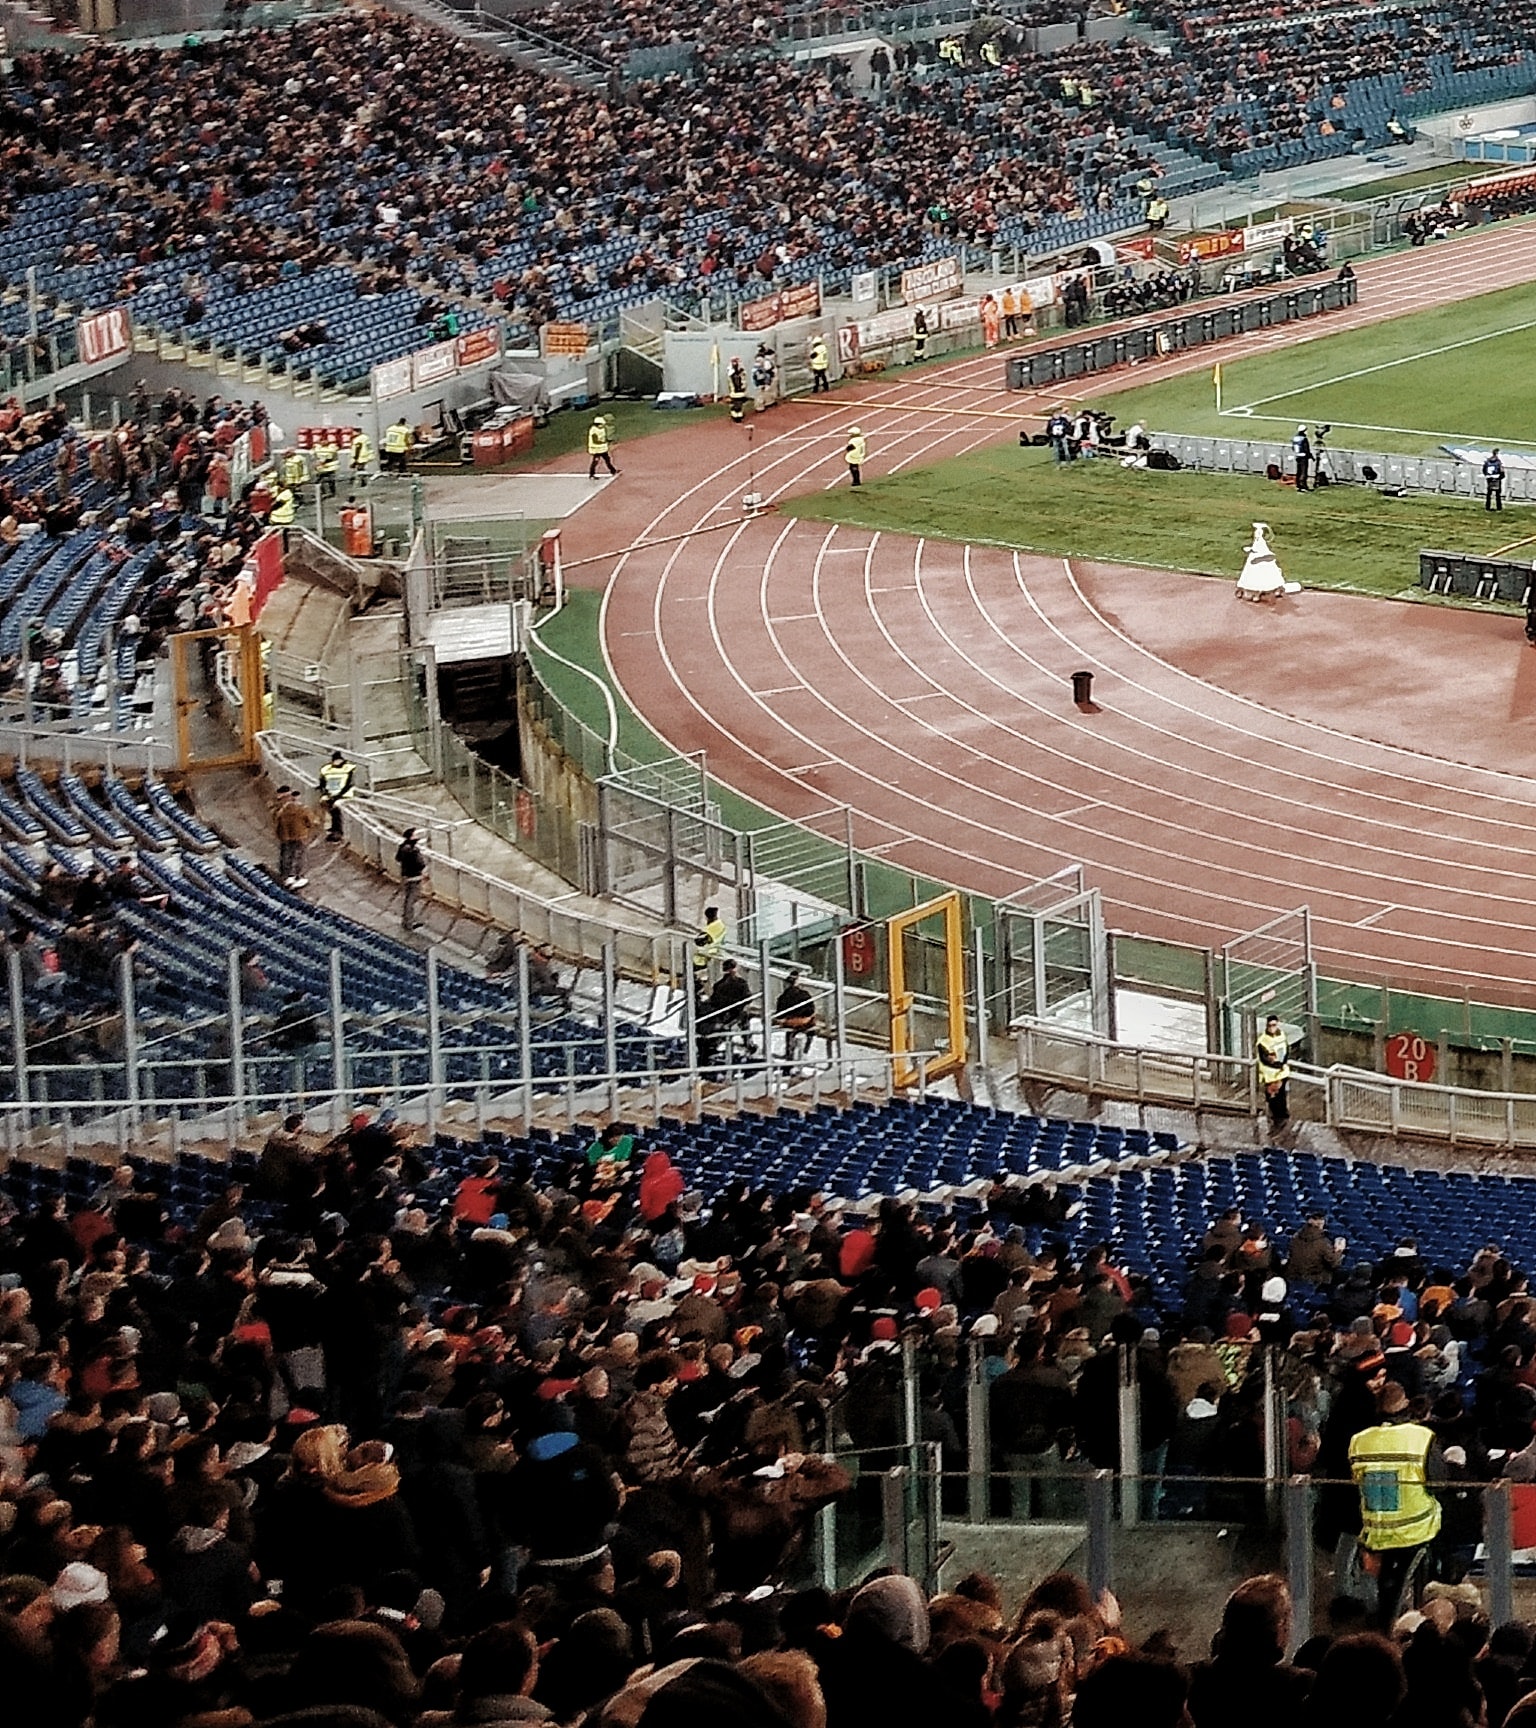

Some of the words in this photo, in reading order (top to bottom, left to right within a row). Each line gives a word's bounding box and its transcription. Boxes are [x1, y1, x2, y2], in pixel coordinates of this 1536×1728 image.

[852, 952, 863, 972] B
[1397, 1035, 1426, 1061] 20
[1404, 1060, 1418, 1082] B
